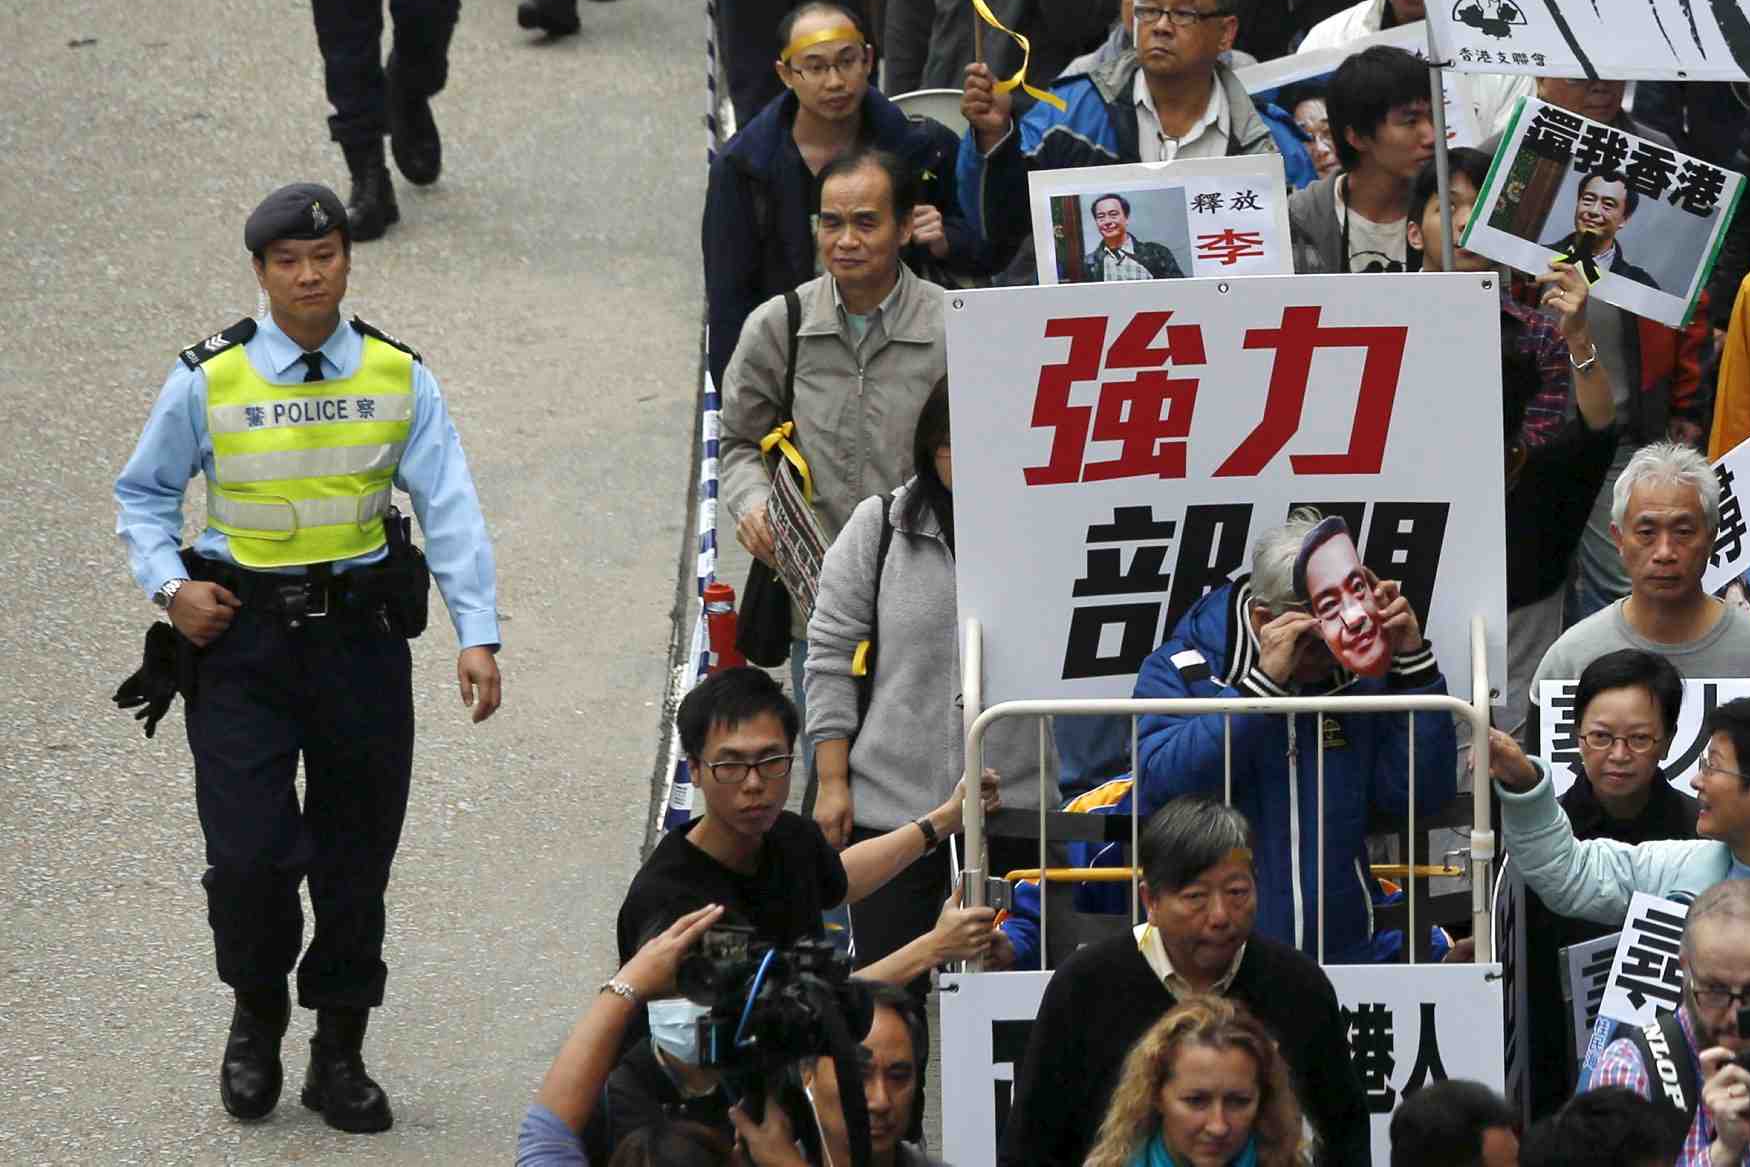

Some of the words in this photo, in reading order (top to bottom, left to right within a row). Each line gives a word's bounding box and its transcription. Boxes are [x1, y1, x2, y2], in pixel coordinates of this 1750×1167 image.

[1459, 47, 1545, 67] 香港支聯會
[1527, 103, 1728, 220] 還我香港
[1191, 187, 1264, 216] 釋放
[1197, 227, 1265, 267] 李
[274, 399, 348, 424] POLICE
[1023, 306, 1409, 486] 強力
